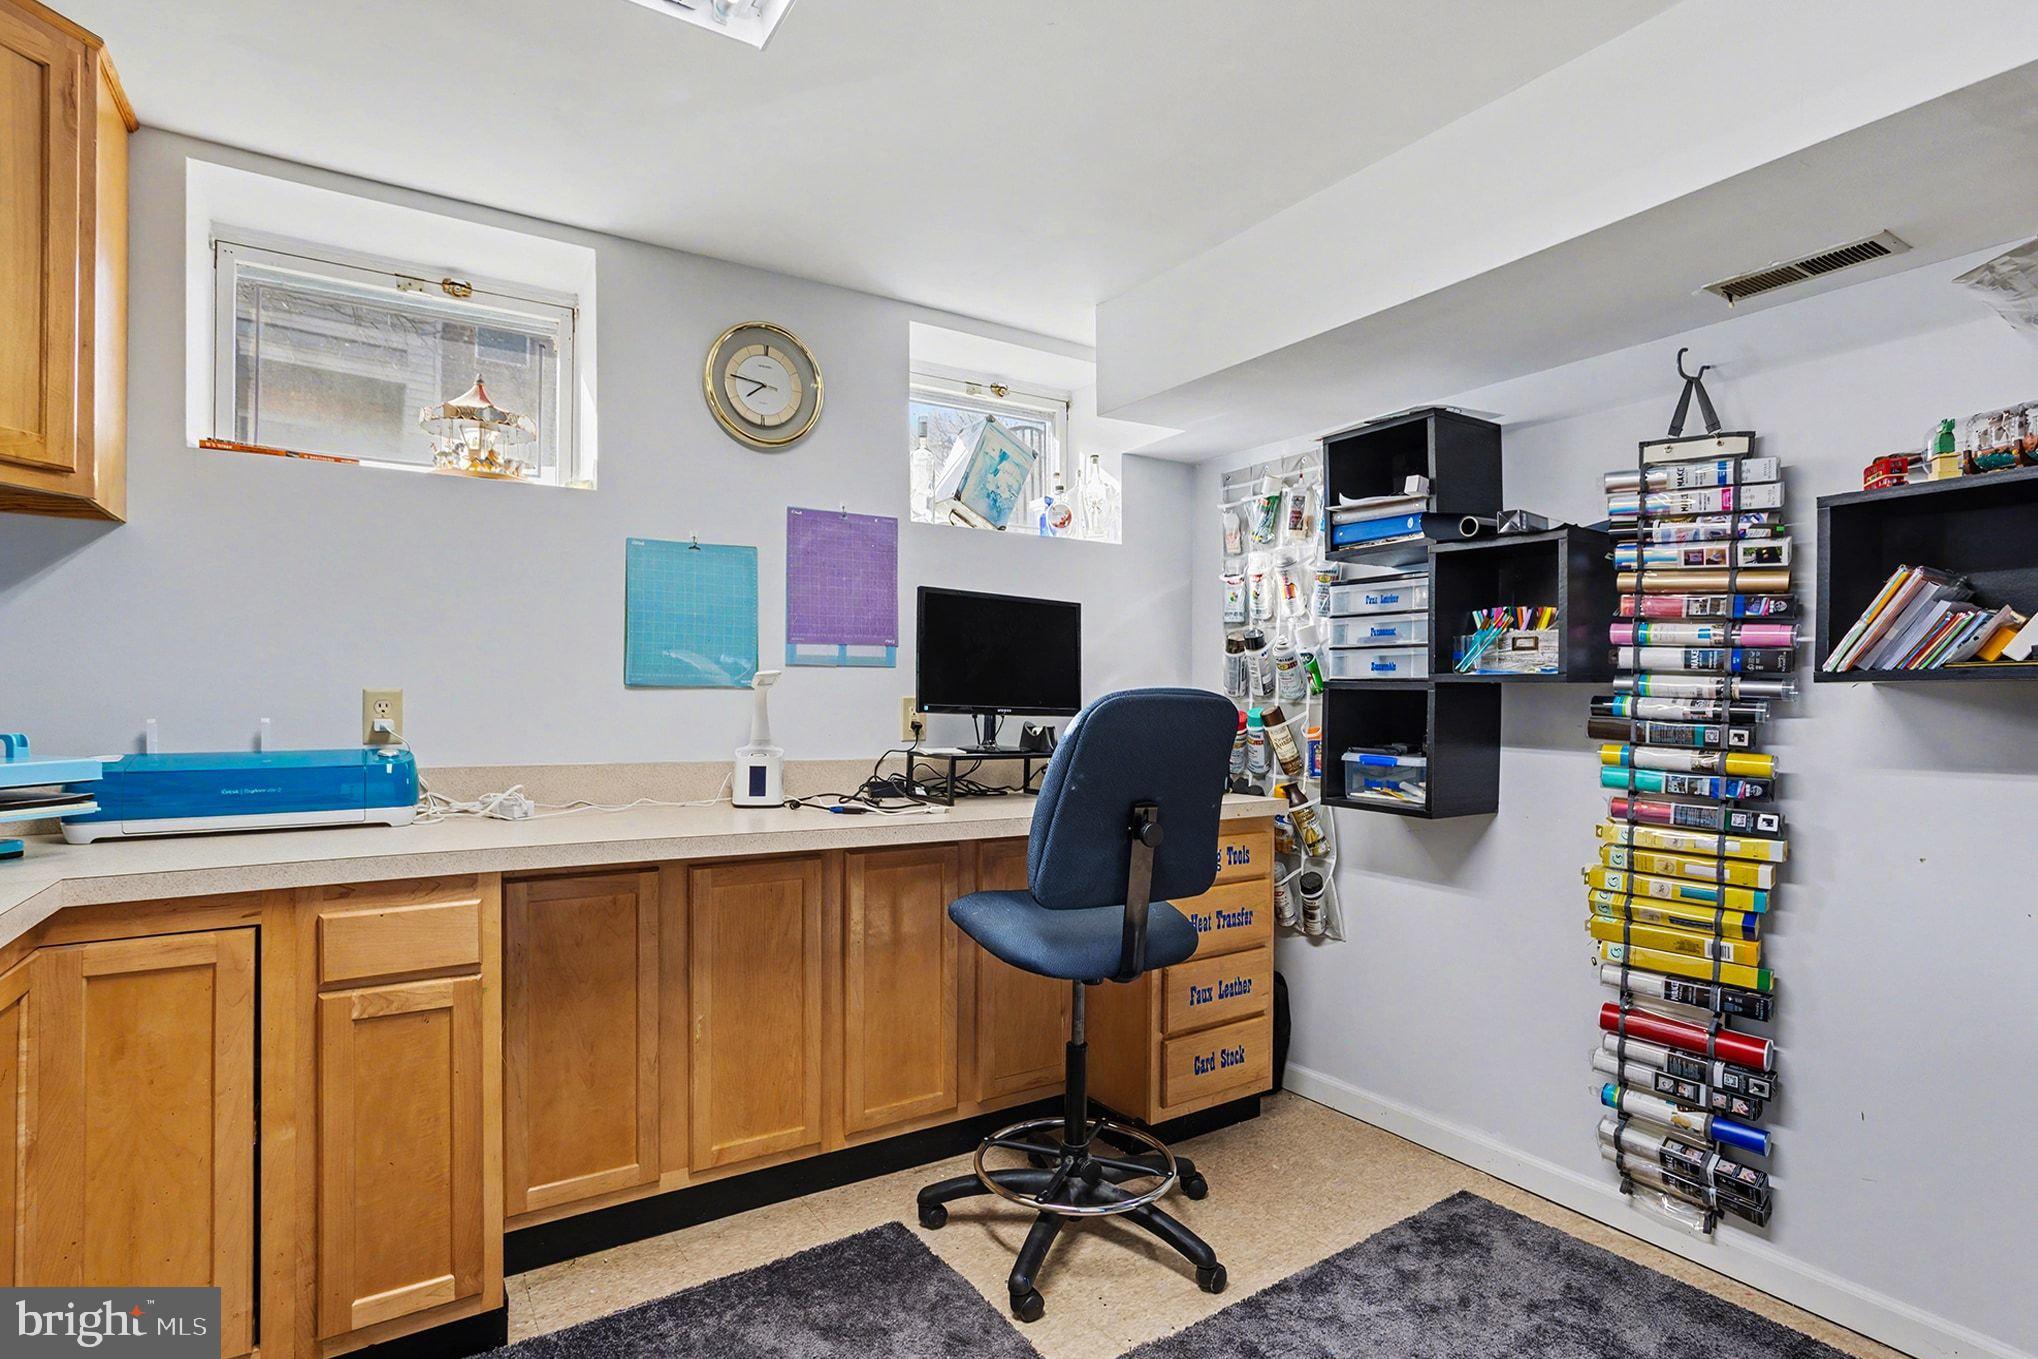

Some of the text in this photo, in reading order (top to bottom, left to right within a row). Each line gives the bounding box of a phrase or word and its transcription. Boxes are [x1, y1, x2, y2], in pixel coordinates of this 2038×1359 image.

[1690, 648, 1699, 670] MAKE
[1226, 845, 1250, 865] Tools
[1216, 907, 1253, 930] Transfer
[1190, 976, 1252, 1006] Faux Leather
[1194, 1044, 1245, 1075] Card Stock
